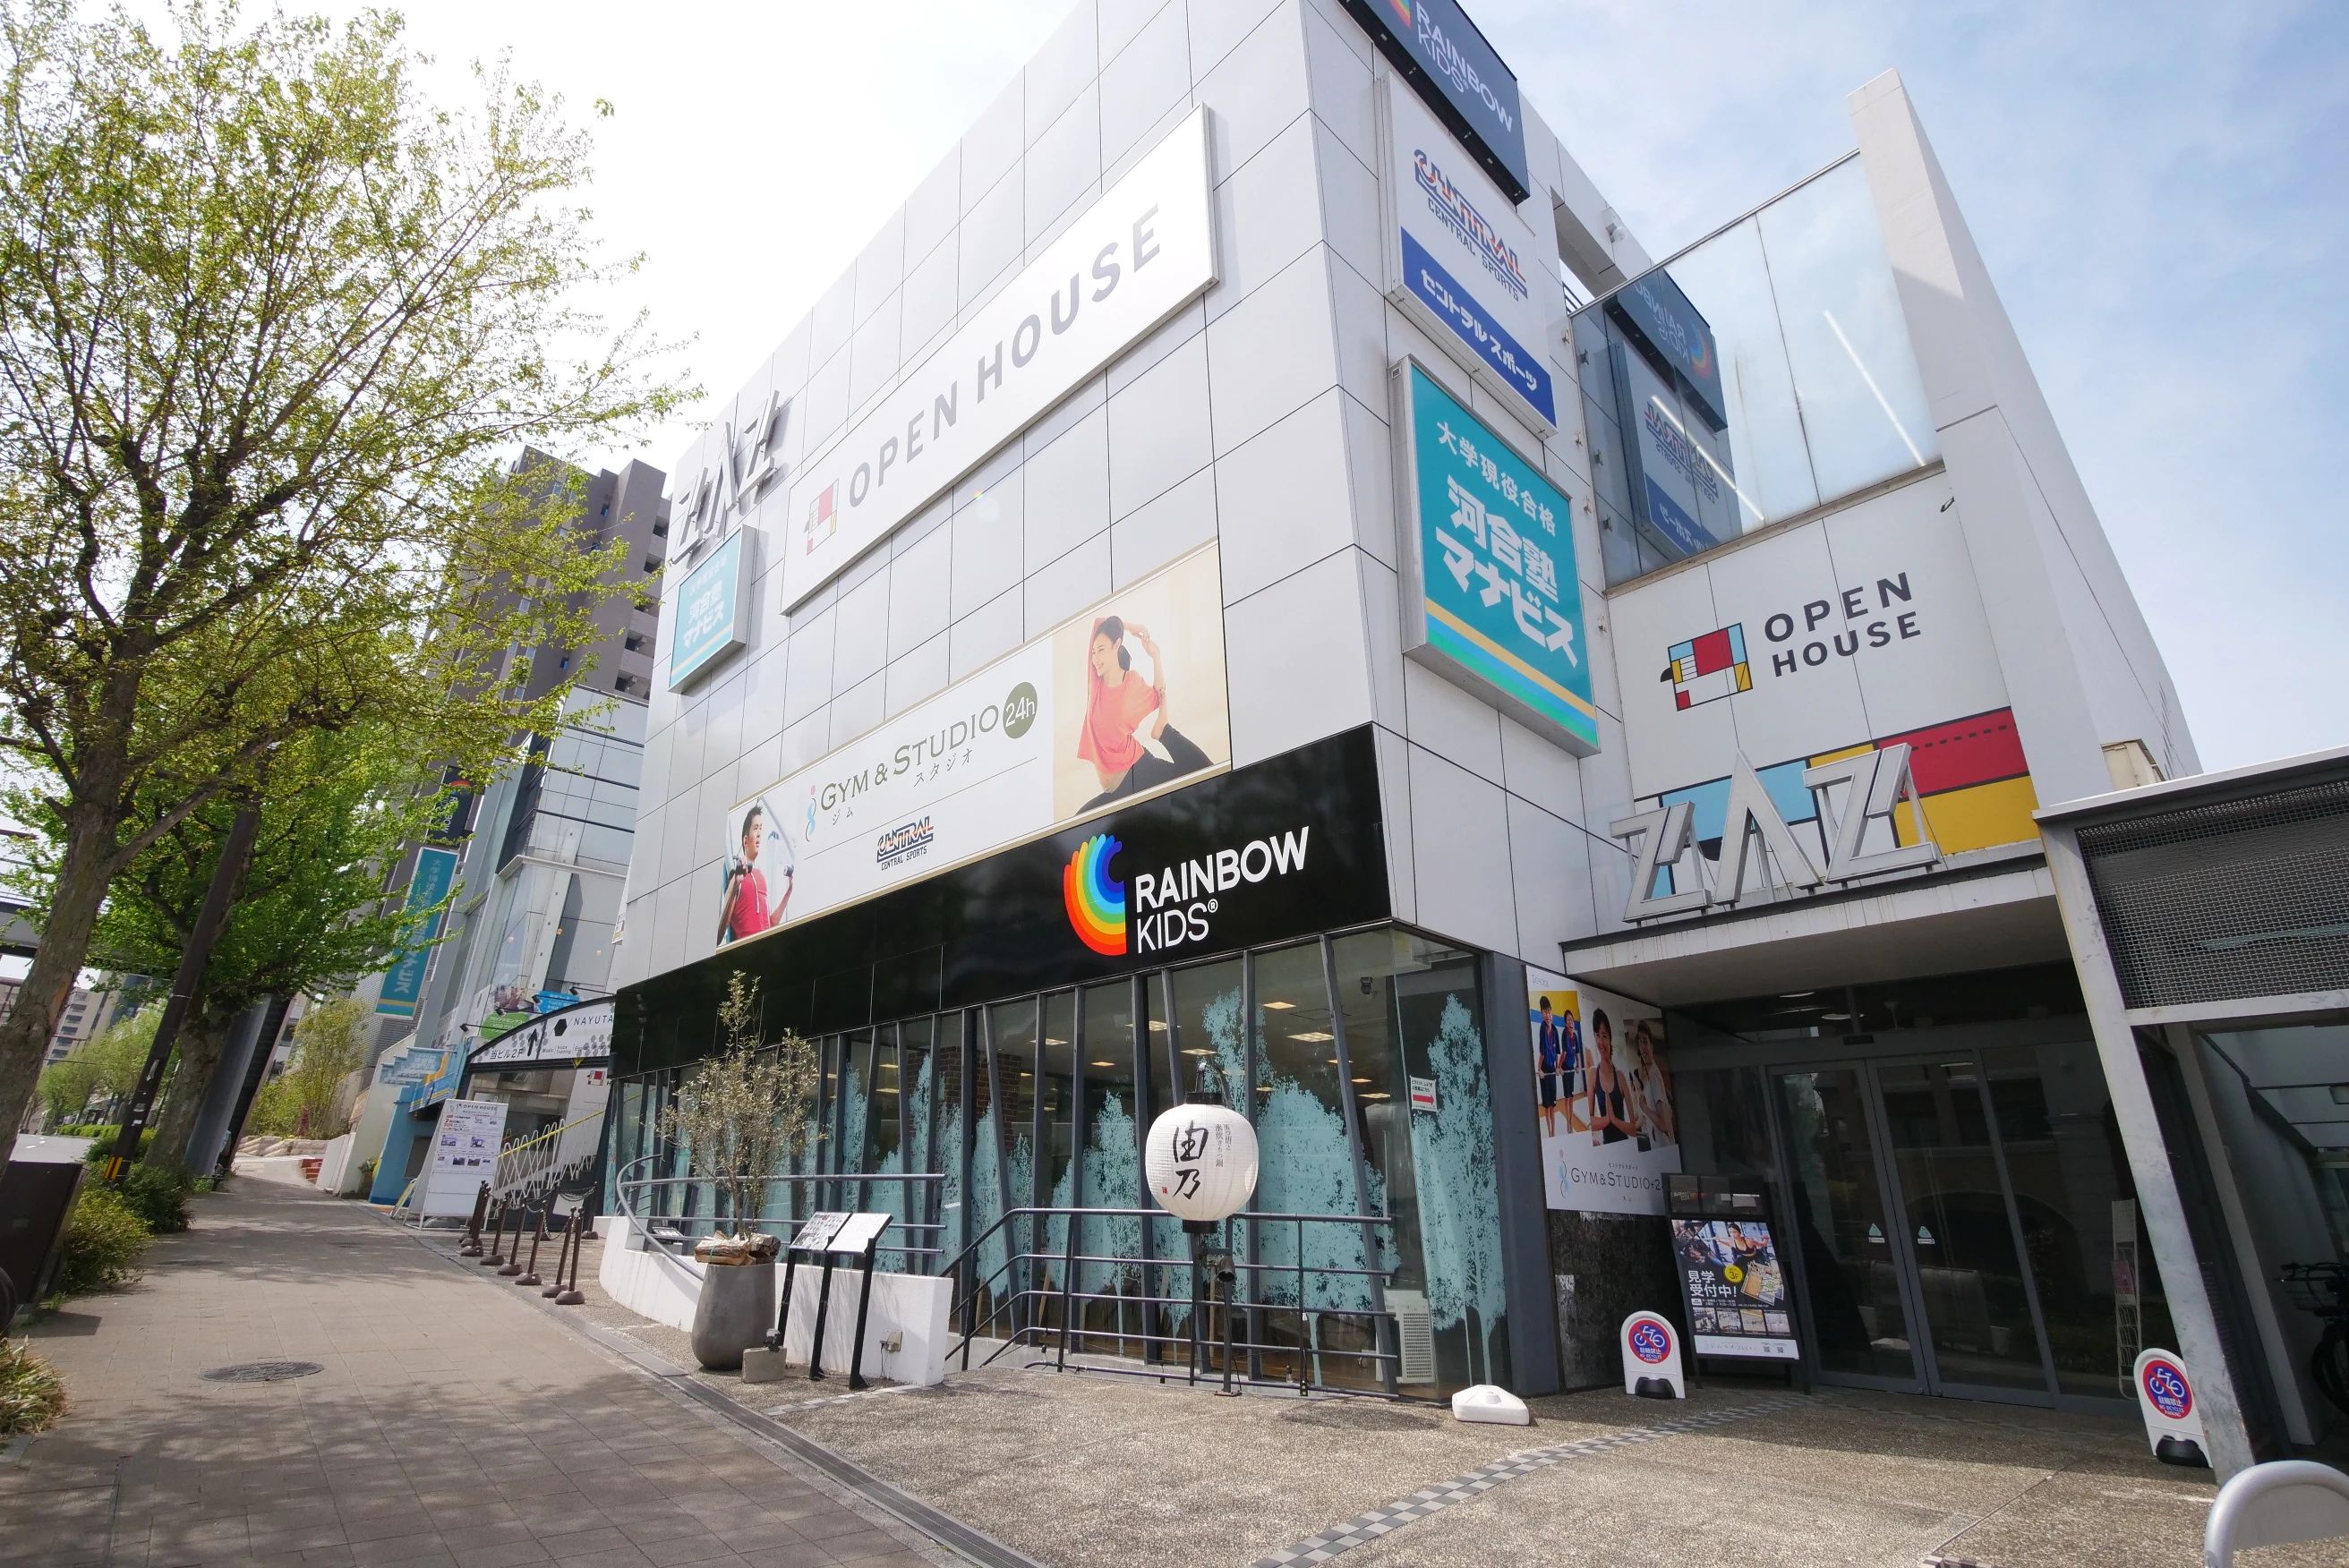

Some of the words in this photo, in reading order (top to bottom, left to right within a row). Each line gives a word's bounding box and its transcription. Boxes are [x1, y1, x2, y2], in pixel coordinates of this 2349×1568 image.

[1416, 2, 1512, 133] RAINBOW
[1427, 197, 1475, 257] CENTRAL
[1482, 254, 1519, 303] SPORTS
[849, 380, 958, 507] OPEN
[977, 202, 1161, 405] HOUSE
[1437, 420, 1556, 537] 大学現役合格
[1447, 473, 1559, 603] 河合塾
[1436, 526, 1578, 669] マナビス
[1764, 572, 1913, 642] OPEN
[1771, 610, 1922, 677] HOUSE
[820, 770, 869, 811] GYM
[874, 763, 888, 786] &
[893, 704, 999, 776] STUDIO
[1004, 695, 1036, 728] 24h
[913, 748, 974, 788] スタジオ
[881, 855, 904, 872] CENTRAL
[906, 846, 927, 861] SPORTS
[1135, 825, 1309, 913] RAINBOW
[574, 1014, 613, 1026] NAYUTA
[1687, 1270, 1715, 1284] 見学
[1729, 1271, 1738, 1280] 3F
